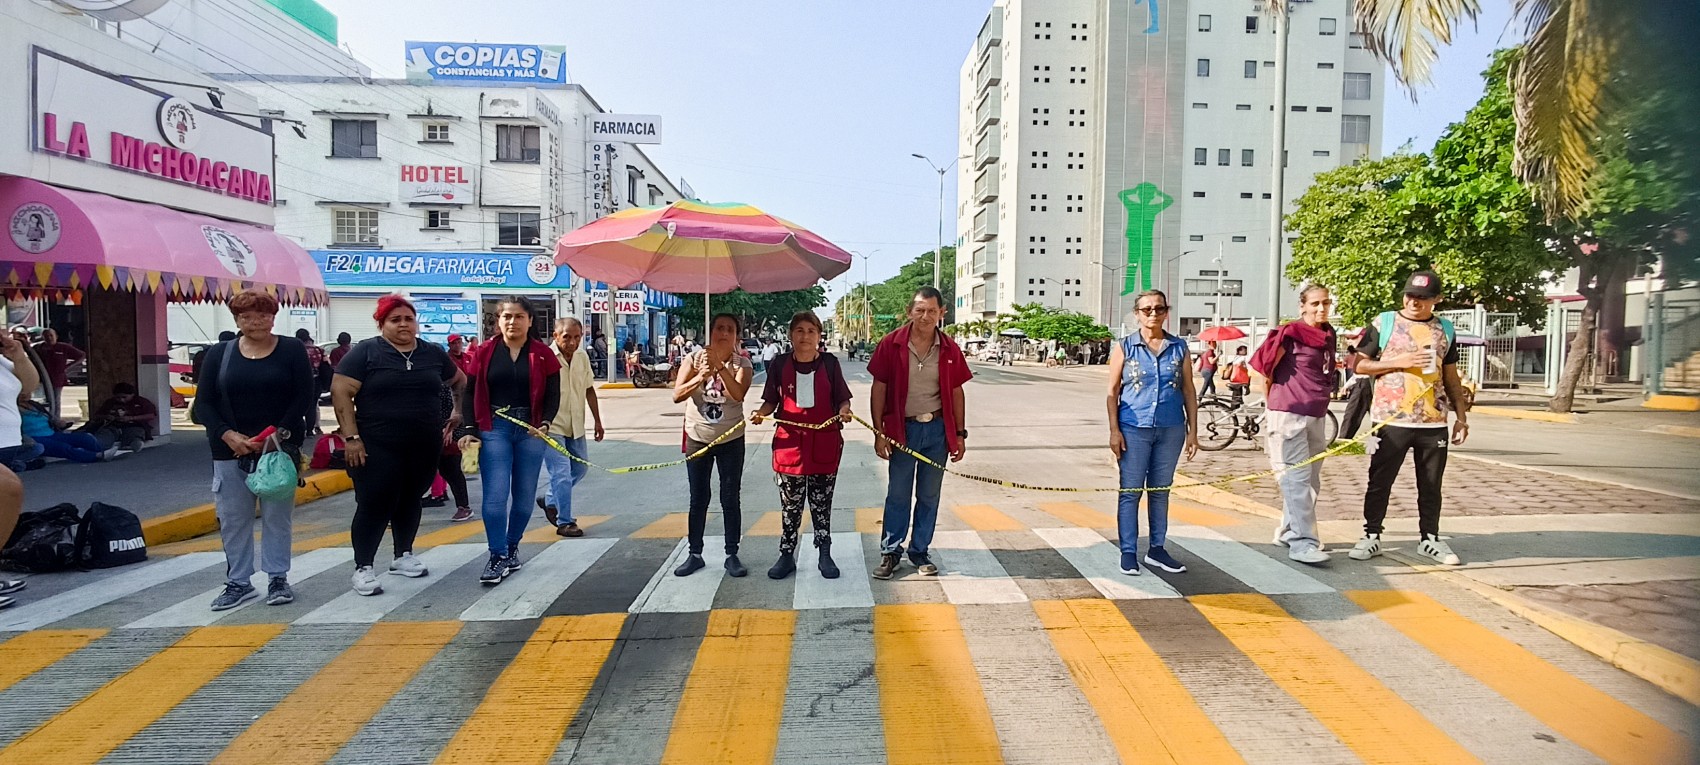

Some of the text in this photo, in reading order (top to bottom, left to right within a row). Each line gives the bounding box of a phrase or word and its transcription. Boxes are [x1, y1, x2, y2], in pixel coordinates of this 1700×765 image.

[434, 45, 537, 68] COPIAS
[436, 67, 536, 78] CONSTANCIAS Y MÁS
[593, 121, 656, 136] FARMACIA
[44, 112, 273, 202] LA MICHOACANA
[401, 165, 469, 184] HOTEL
[593, 144, 601, 219] ORTOPEDI
[364, 256, 425, 274] MEGA
[426, 259, 513, 276] FARMACIA
[534, 262, 550, 272] 24
[593, 291, 639, 299] PAPLERIA
[109, 536, 146, 553] PUMA
